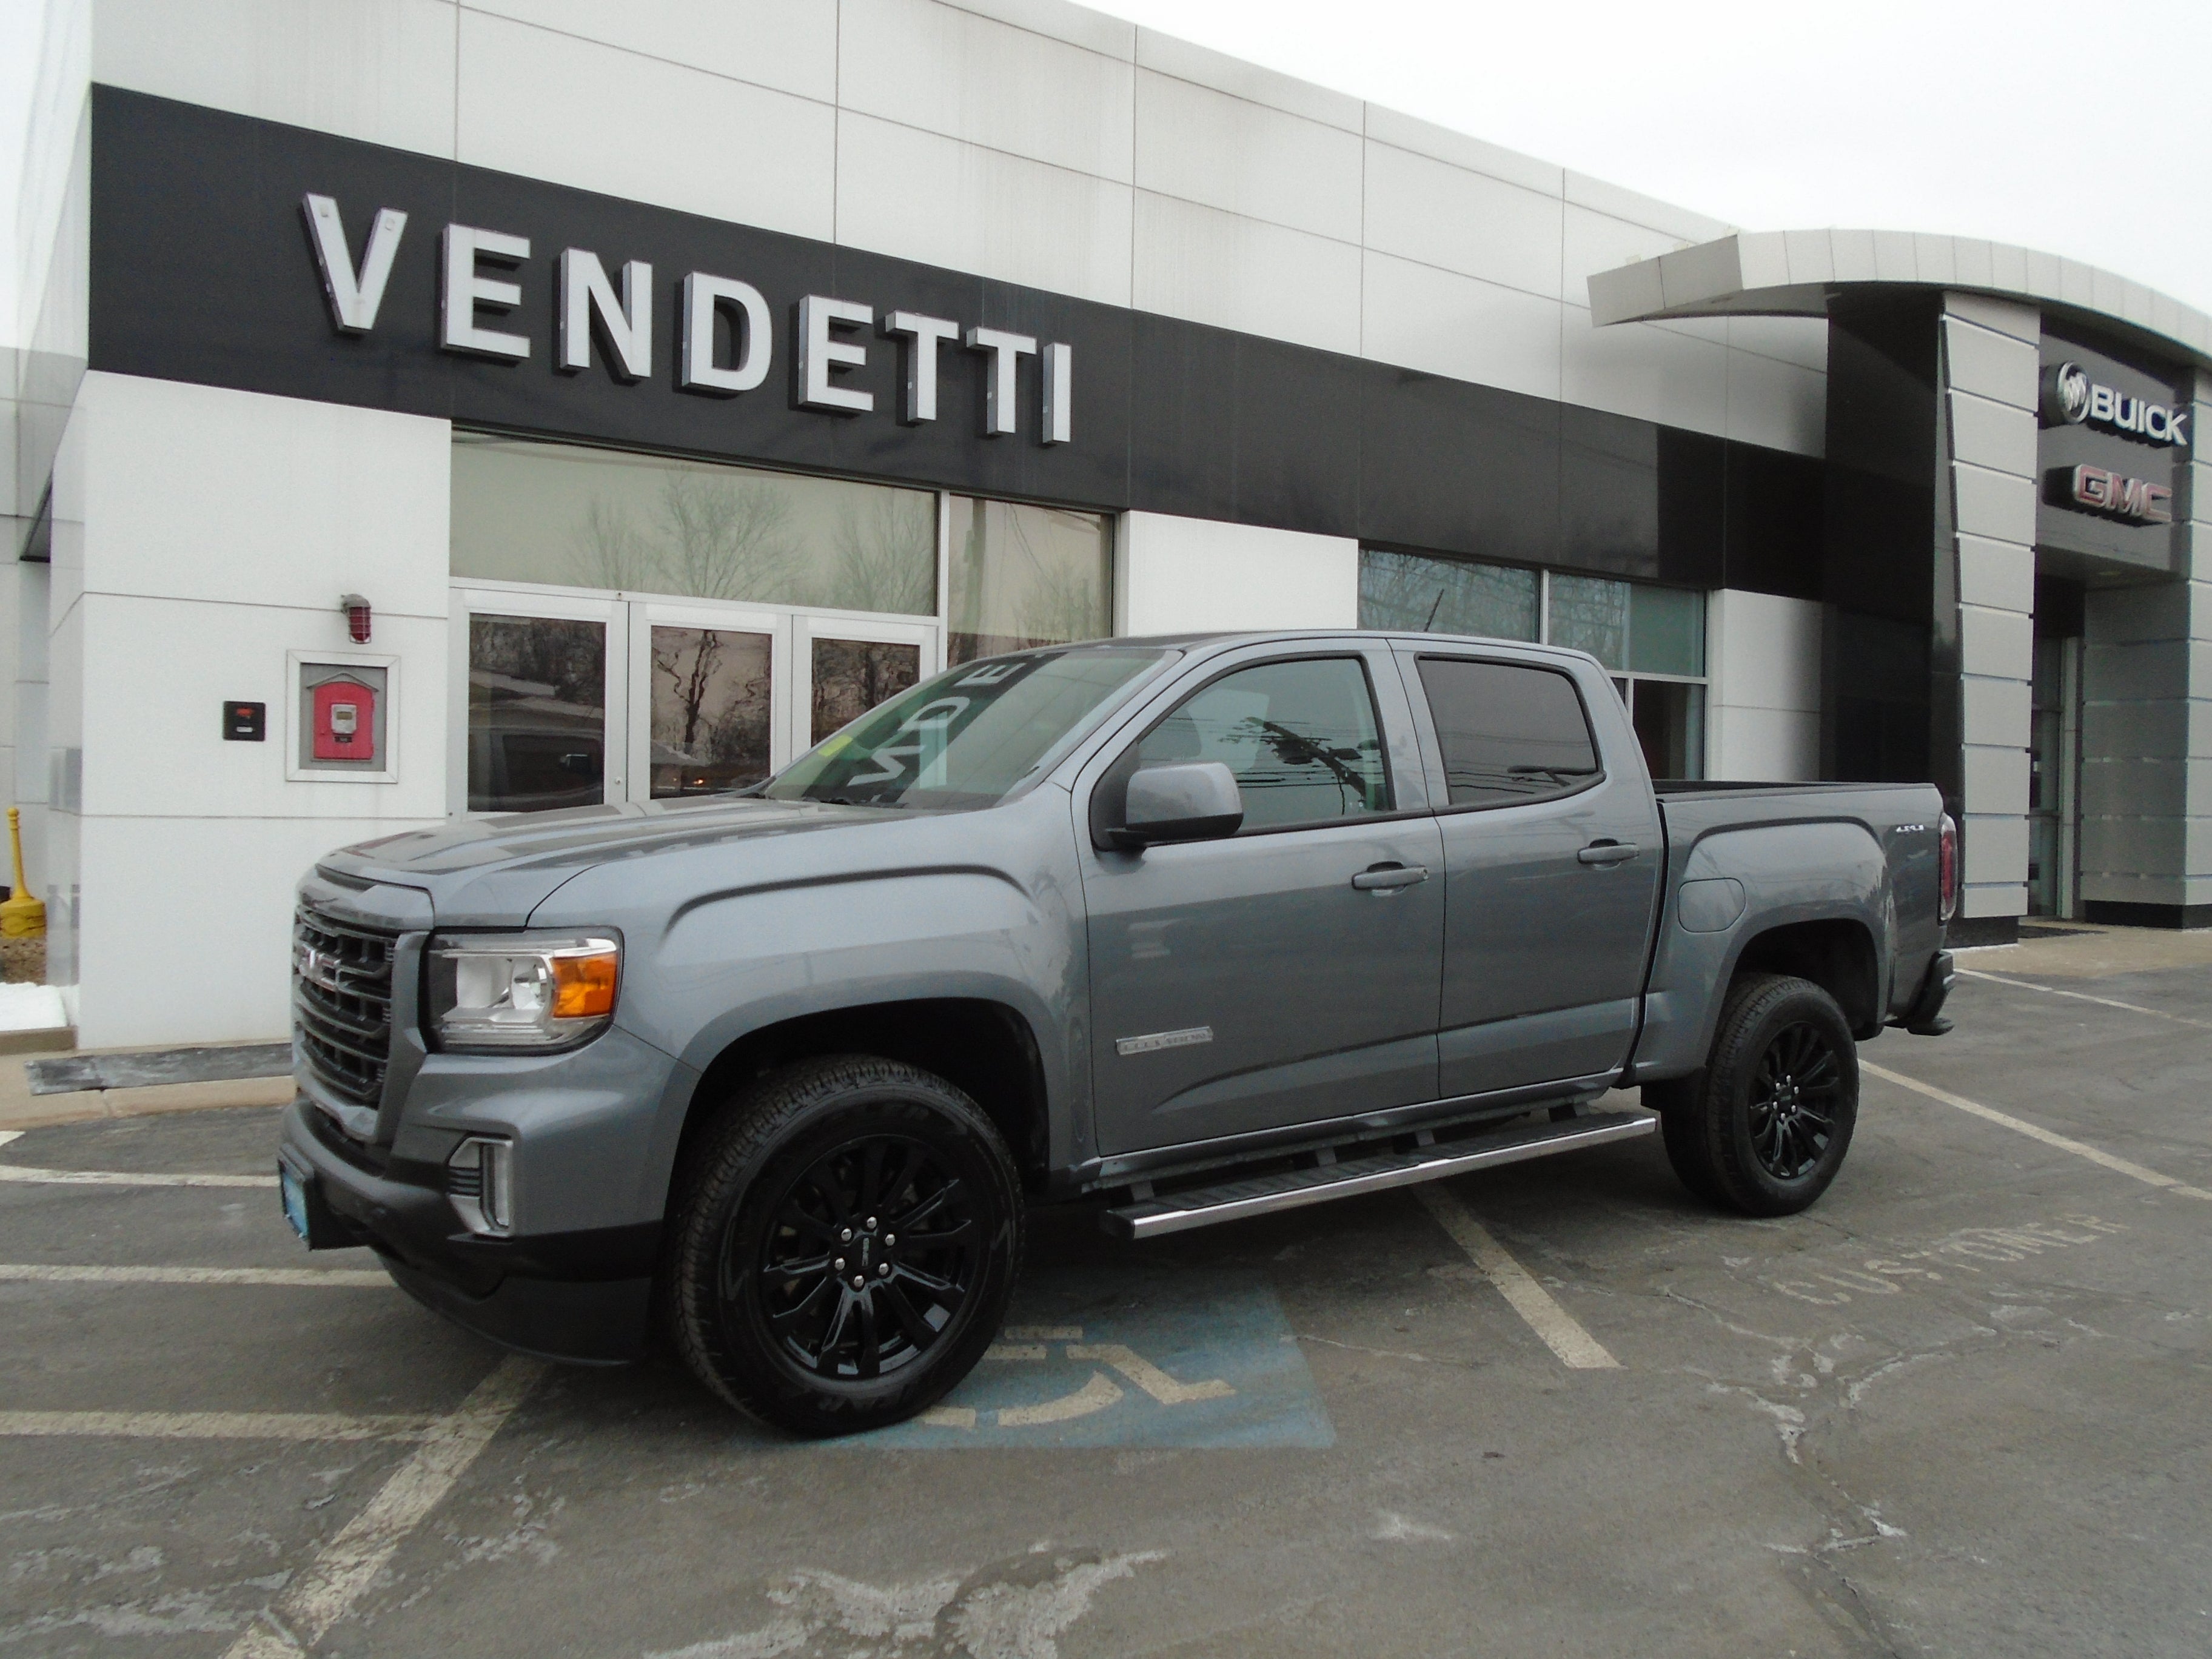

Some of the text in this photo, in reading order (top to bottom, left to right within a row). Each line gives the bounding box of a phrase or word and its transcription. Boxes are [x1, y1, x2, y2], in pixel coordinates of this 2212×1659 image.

[303, 193, 1072, 444] VENDETTI
[2090, 384, 2187, 446] BUICK
[2073, 463, 2172, 522] GMC
[1771, 1212, 2131, 1305] CUSTOMER
